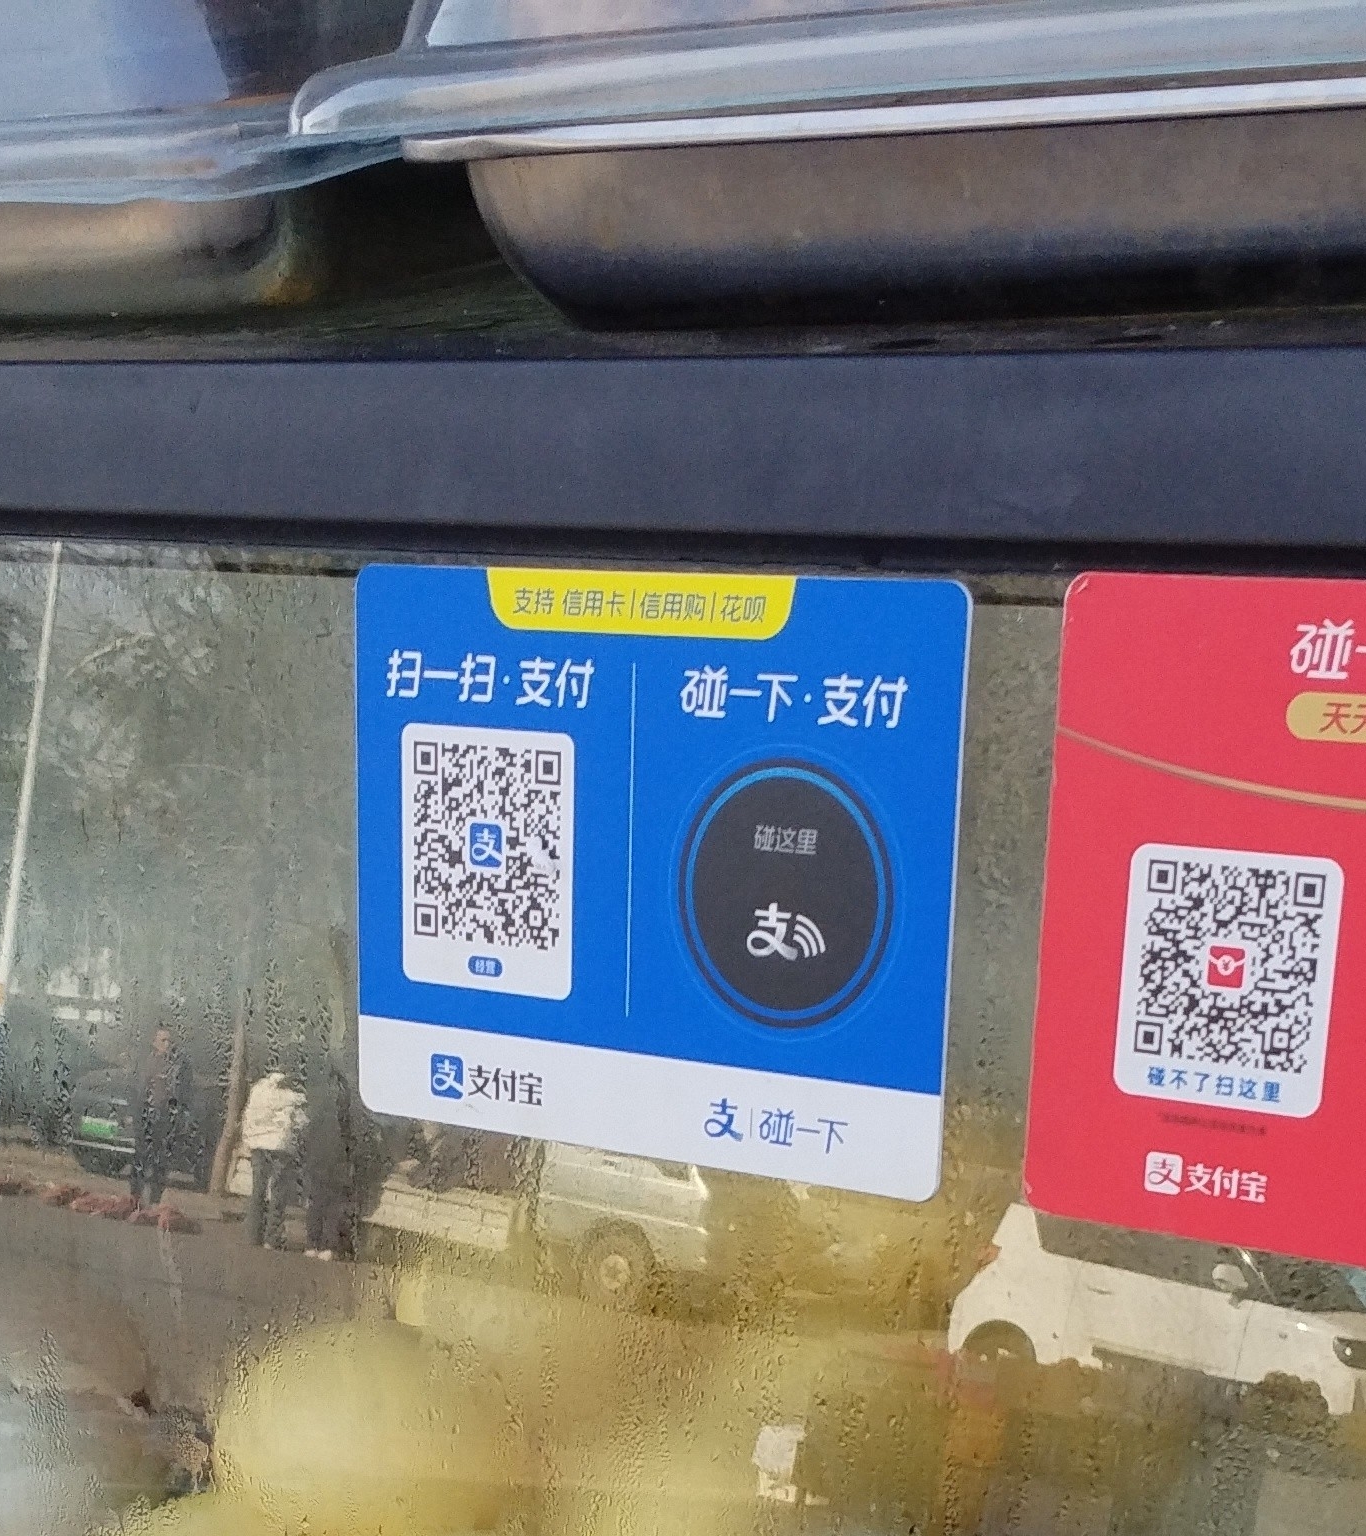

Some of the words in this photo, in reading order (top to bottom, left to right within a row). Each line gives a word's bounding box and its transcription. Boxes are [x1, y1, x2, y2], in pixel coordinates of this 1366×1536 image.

[511, 588, 556, 617] 支持
[753, 824, 819, 856] 碰这里
[467, 1064, 544, 1107] 支付宝
[1146, 1064, 1281, 1103] 碰不了扫这里
[758, 1107, 849, 1155] 碰一下
[1184, 1162, 1268, 1204] 支付宝
